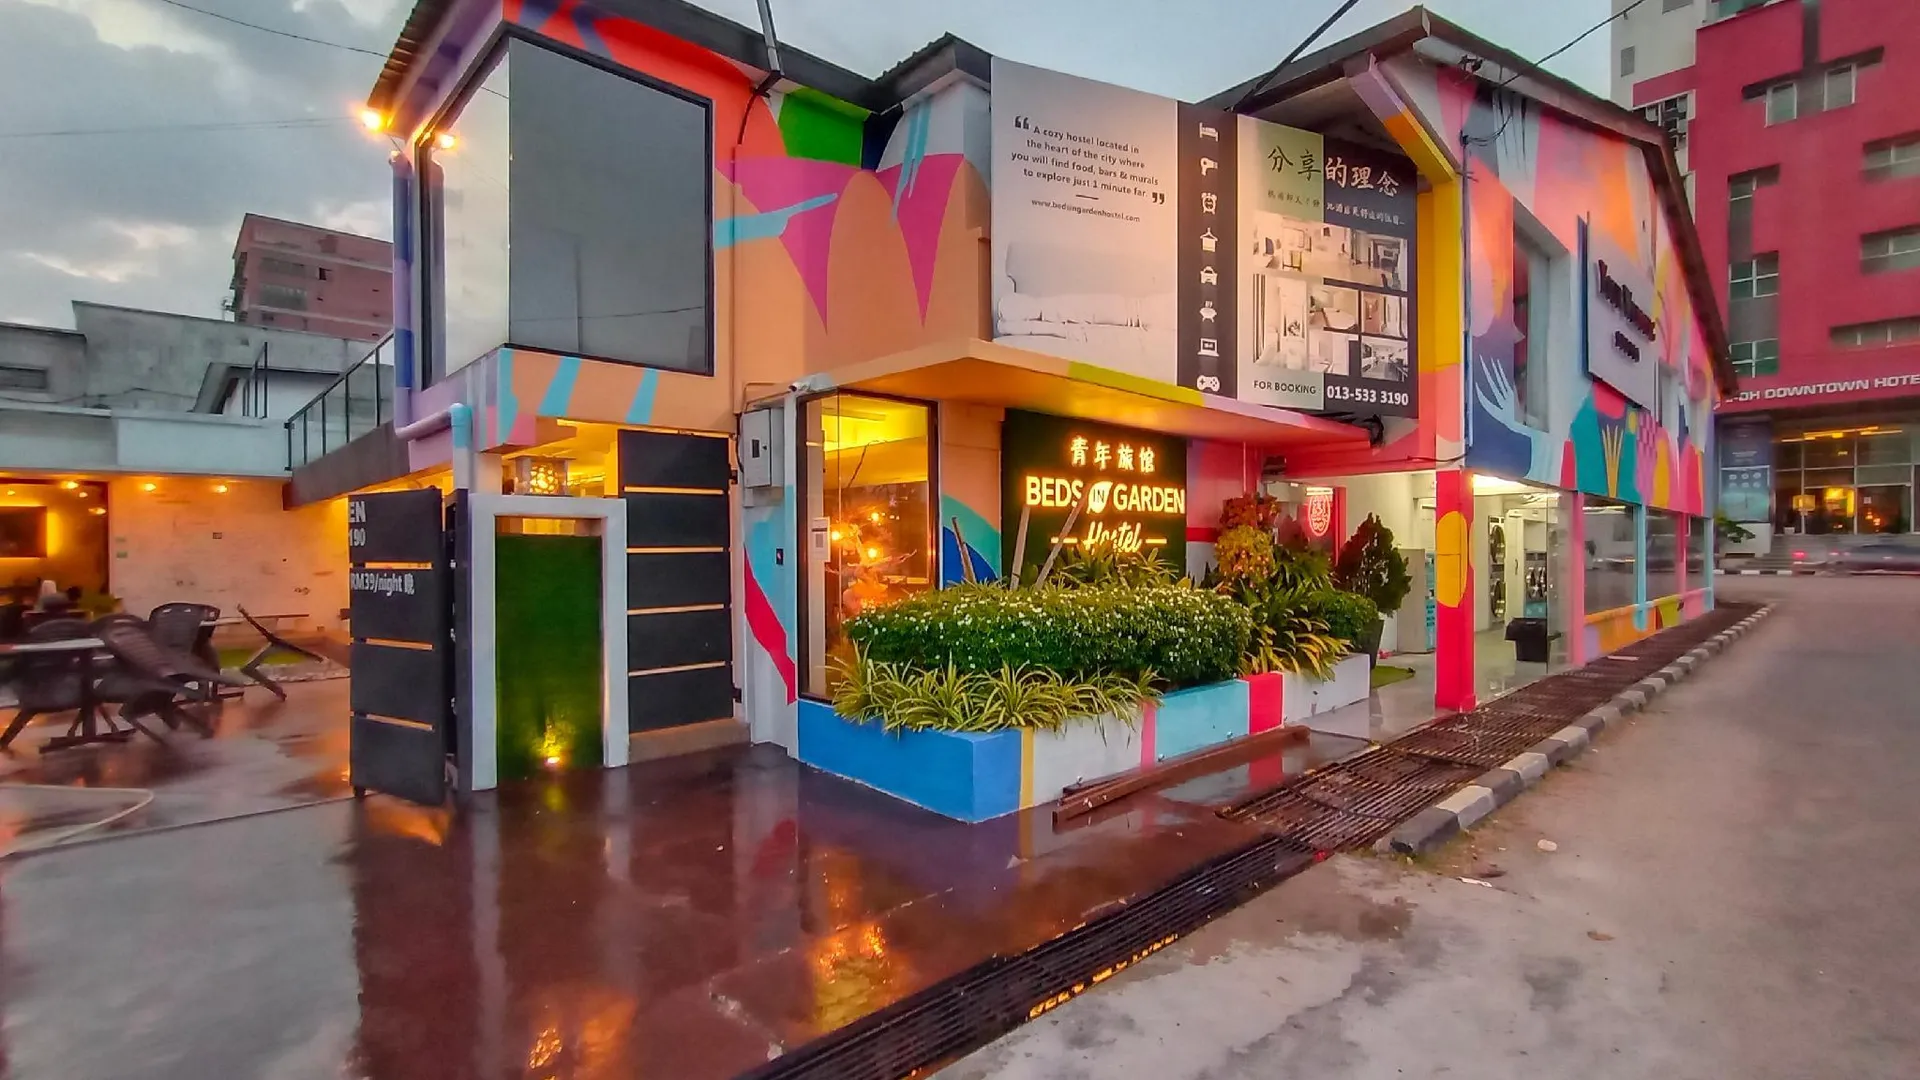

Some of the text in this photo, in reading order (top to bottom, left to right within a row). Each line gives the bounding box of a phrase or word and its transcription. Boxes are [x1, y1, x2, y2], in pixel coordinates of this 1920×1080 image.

[1026, 139, 1145, 169] the heart of the city where
[1033, 126, 1140, 154] A cozy hostel located in
[1011, 151, 1159, 186] you will find food, bars & murals
[1023, 168, 1034, 177] to
[1036, 171, 1071, 183] explore
[1072, 176, 1090, 188] just
[1092, 180, 1098, 188] 1
[1100, 182, 1132, 194] minute
[1267, 145, 1400, 198] 分享的理念
[1253, 379, 1317, 395] FOR BOOKING
[1326, 385, 1410, 406] 013-533 3190
[1764, 378, 1869, 400] DOWNTOWN
[1070, 435, 1156, 474] 青年旅馆
[1026, 475, 1185, 514] BEDS IN GARDEN
